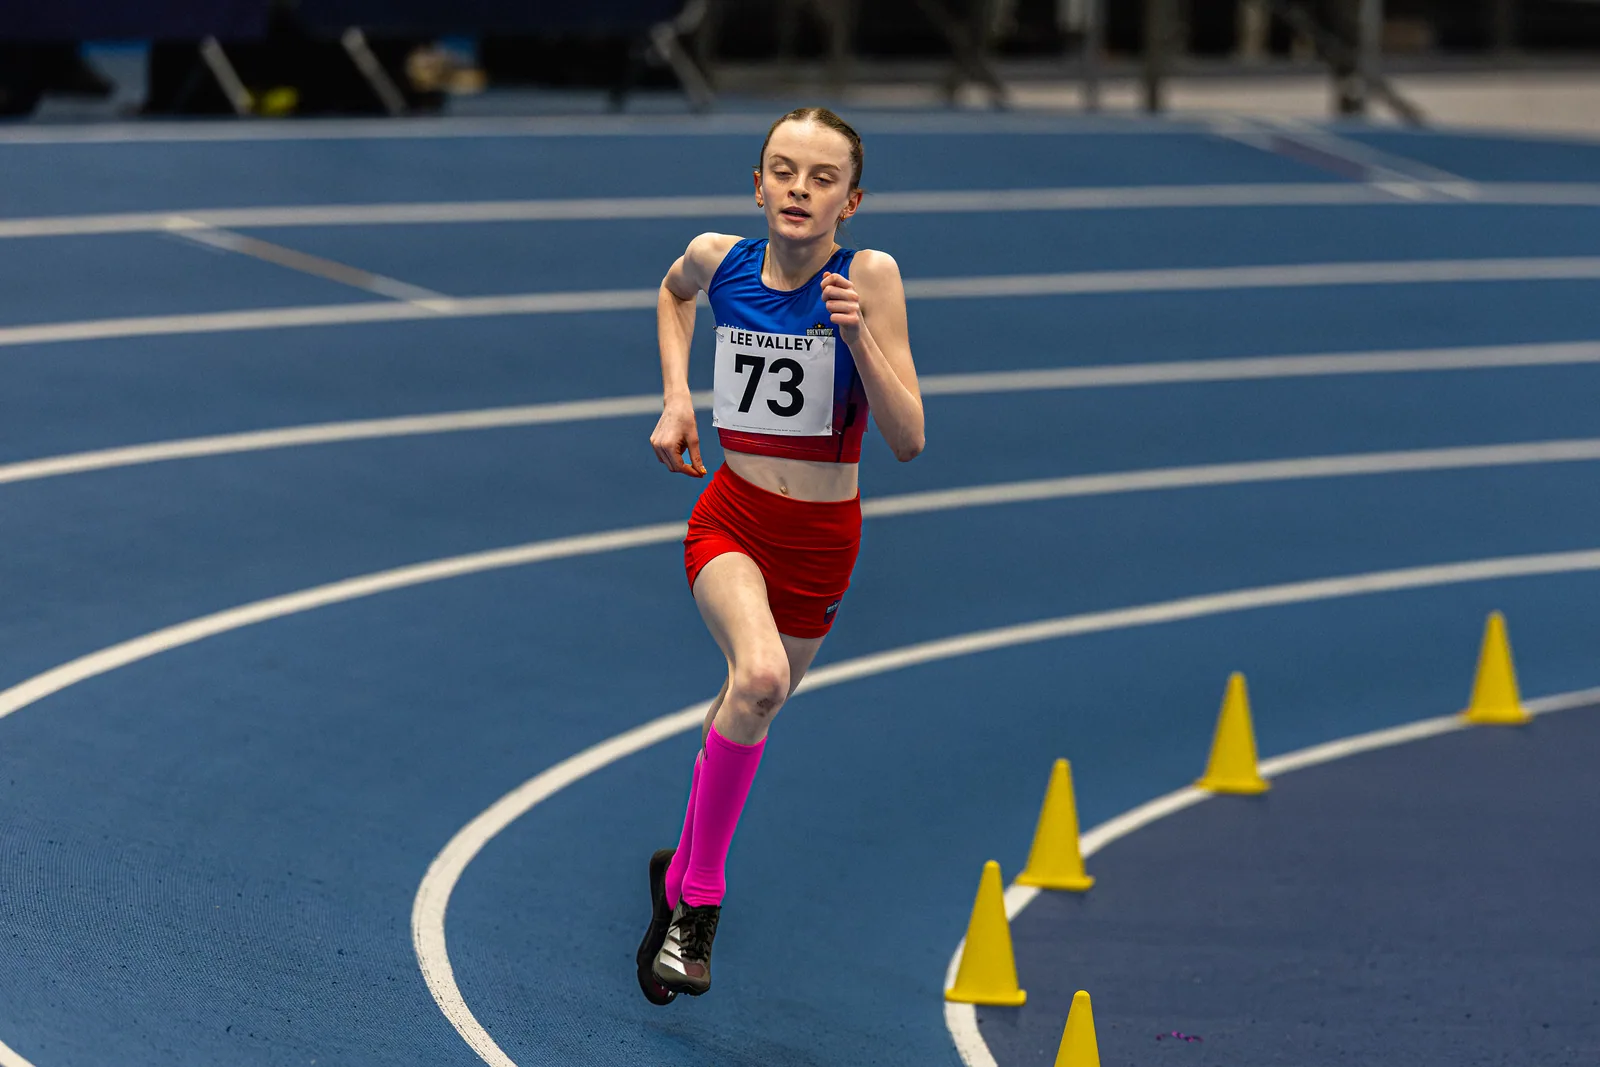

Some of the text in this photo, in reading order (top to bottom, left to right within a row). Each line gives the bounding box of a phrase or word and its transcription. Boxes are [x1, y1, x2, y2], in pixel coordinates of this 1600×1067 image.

[730, 331, 814, 351] LEE VALLEY
[734, 353, 804, 417] 73
